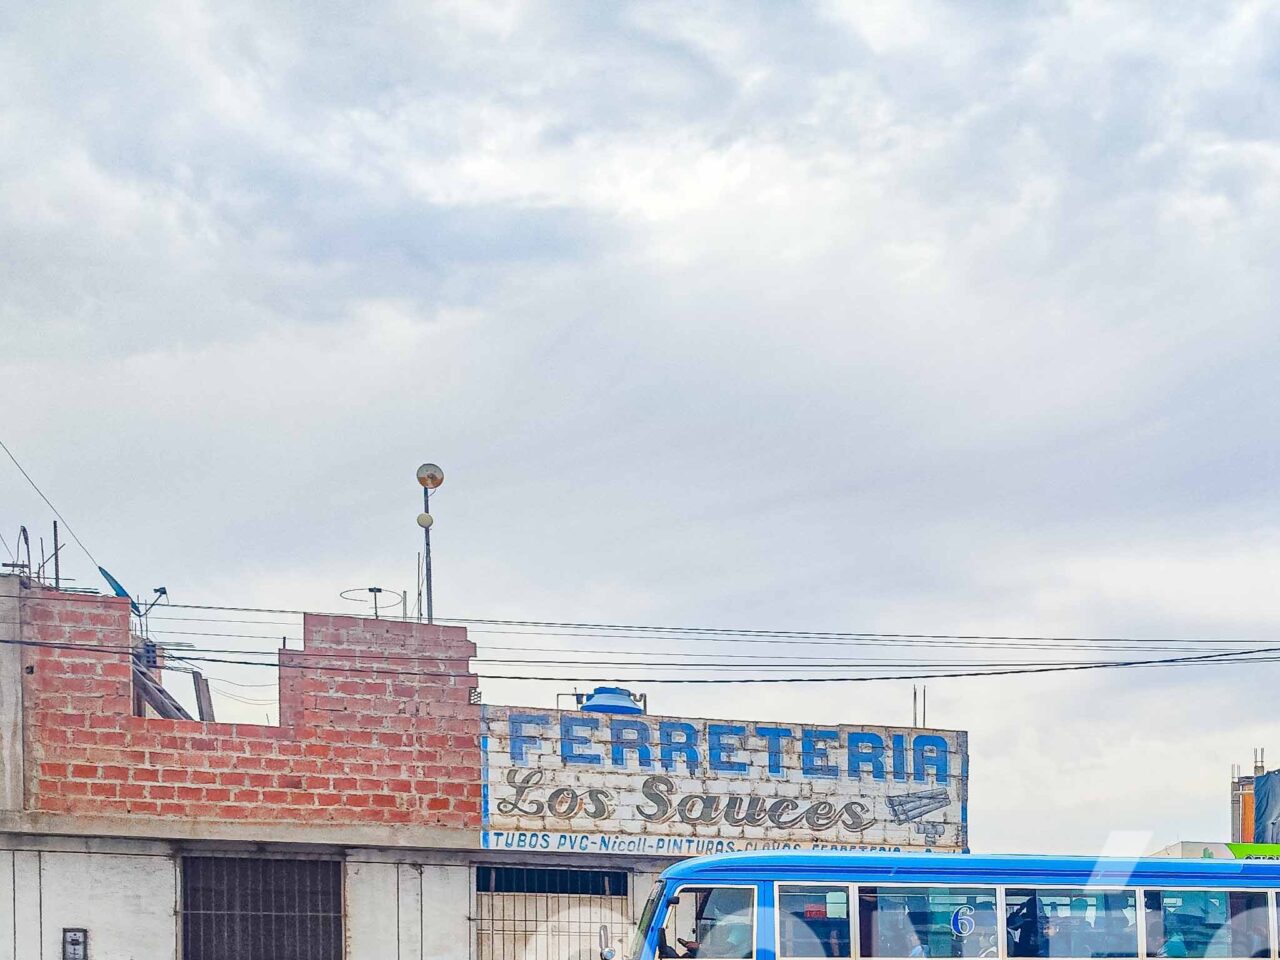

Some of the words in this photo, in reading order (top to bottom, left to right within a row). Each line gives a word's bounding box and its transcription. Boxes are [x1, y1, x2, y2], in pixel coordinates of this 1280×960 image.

[507, 713, 950, 783] FERRETERIA
[497, 768, 615, 821] Los
[636, 775, 876, 832] Sauces
[493, 832, 550, 849] TUBOS
[951, 904, 975, 937] 6
